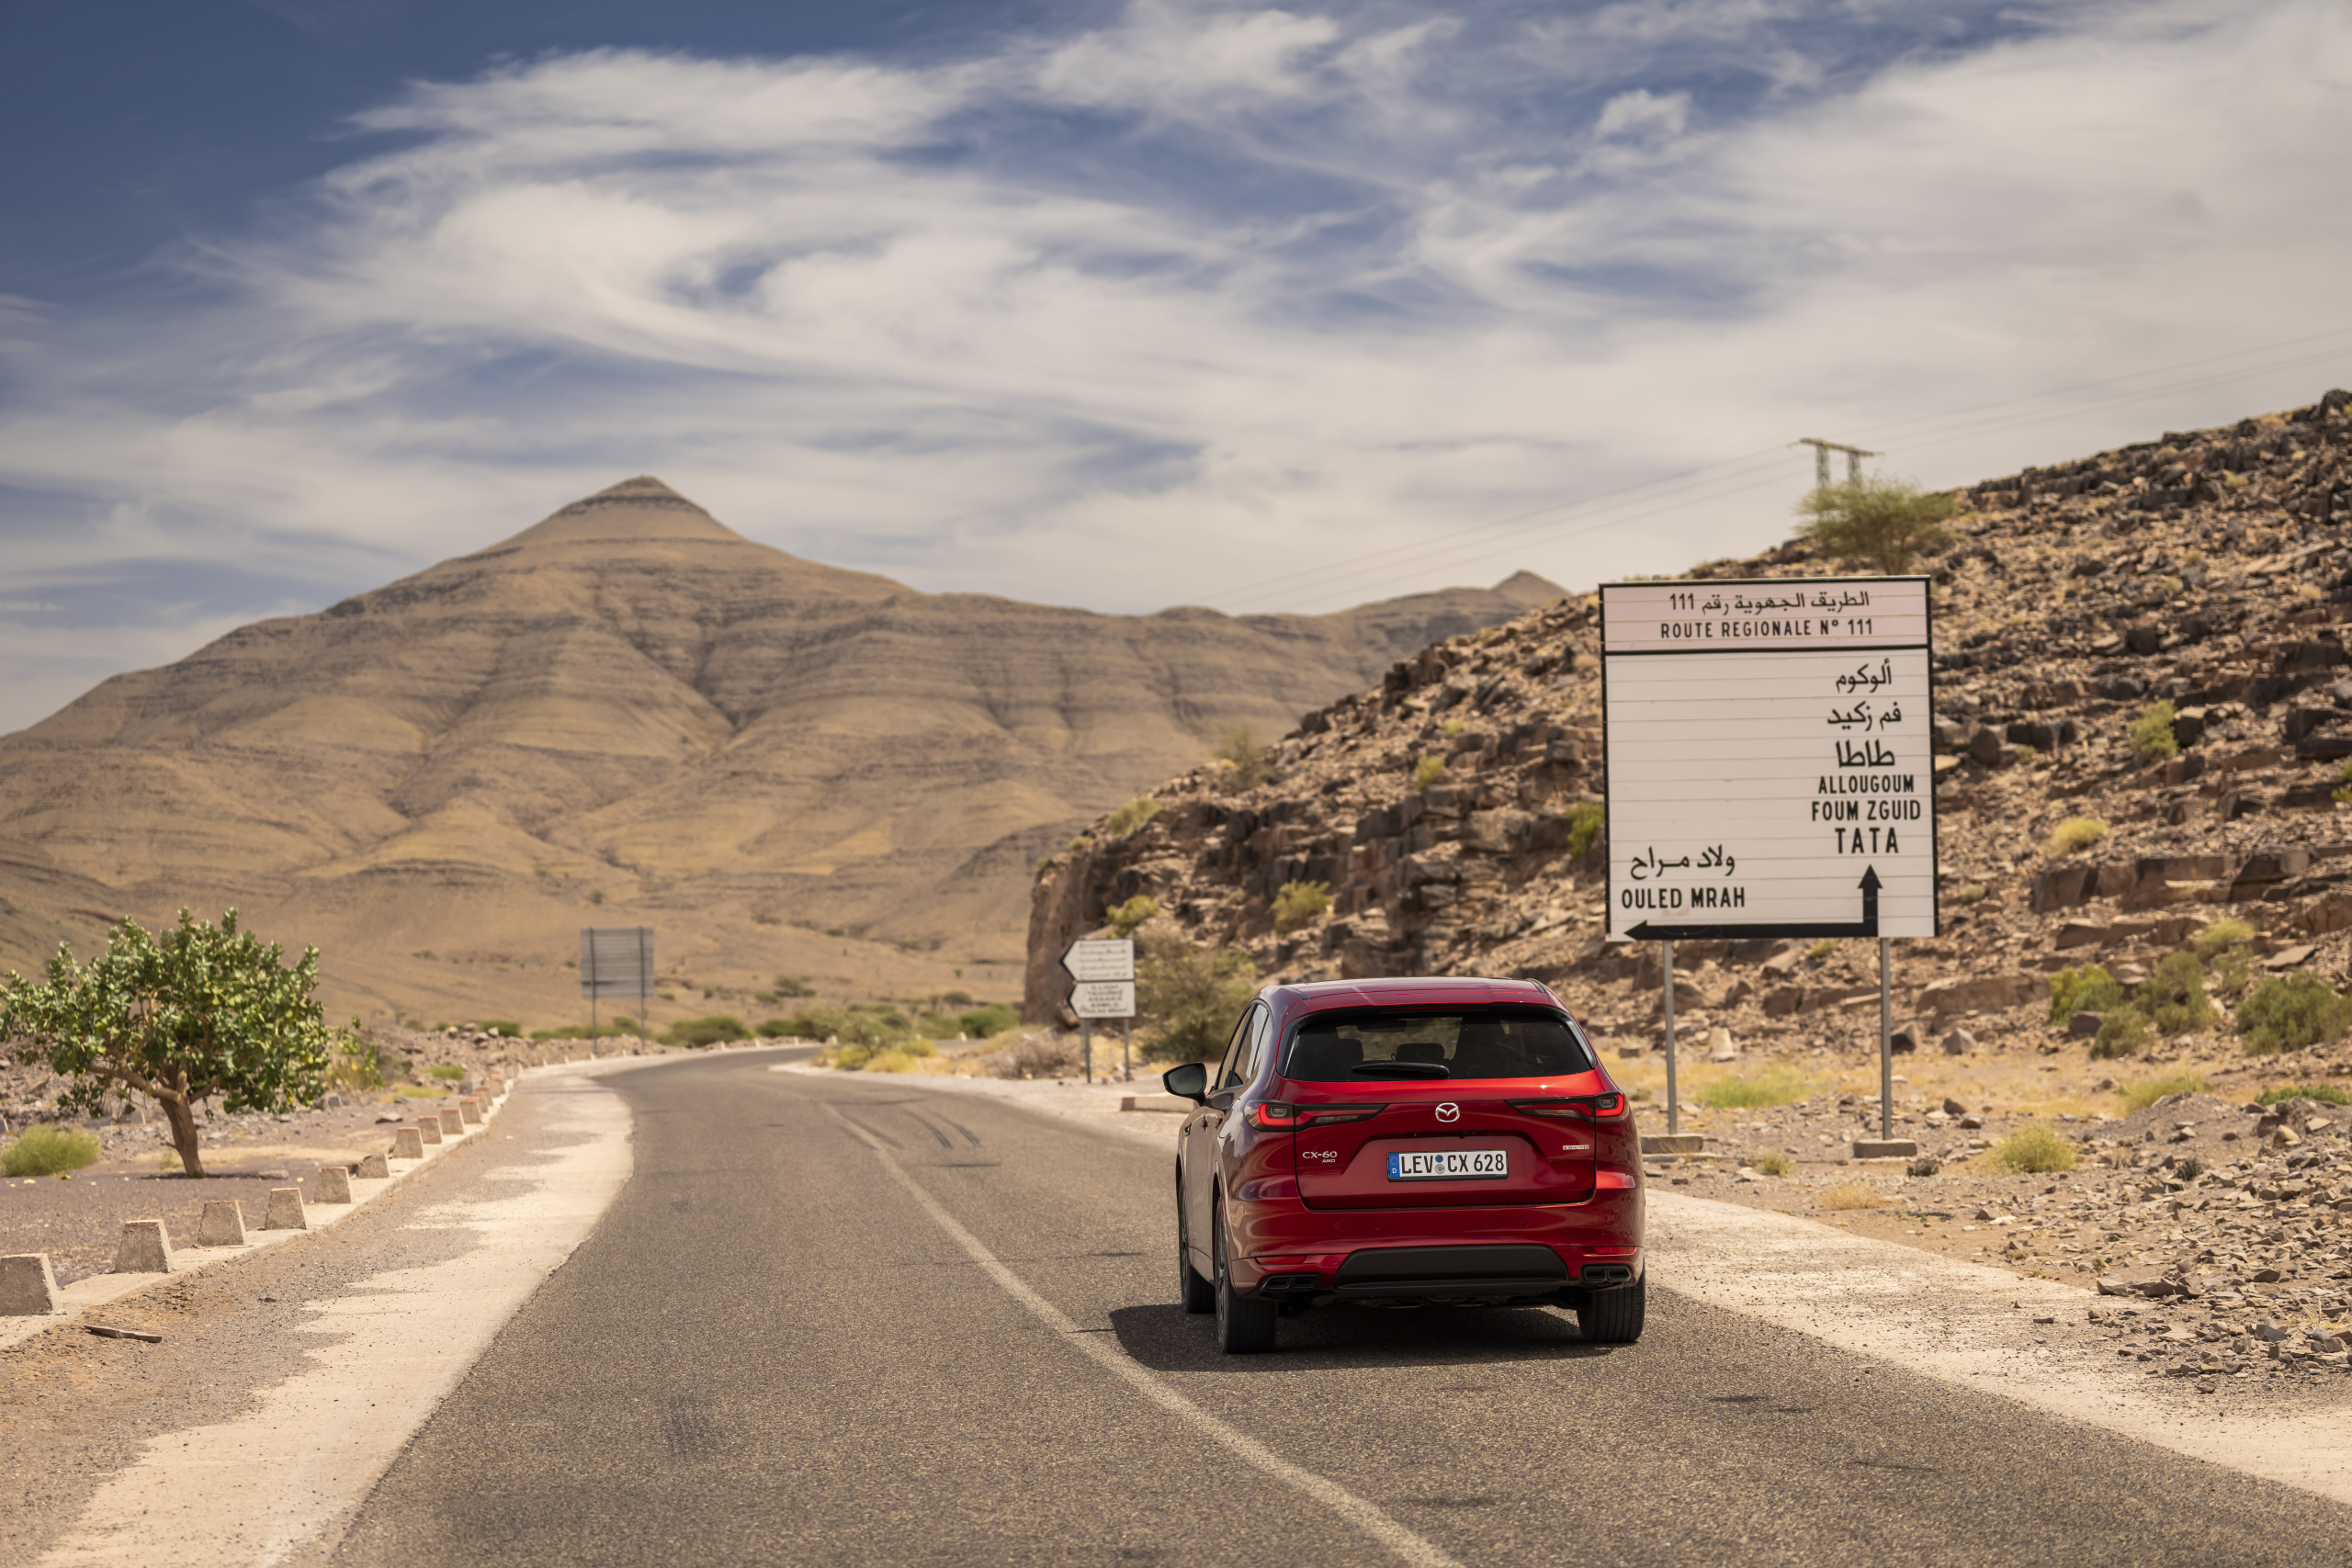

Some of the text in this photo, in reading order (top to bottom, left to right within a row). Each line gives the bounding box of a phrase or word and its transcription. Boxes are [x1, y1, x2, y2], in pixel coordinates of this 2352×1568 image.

[1669, 591, 1869, 615] الطريق الجهوية رقم 111
[1661, 622, 1713, 638] ROUTE
[1721, 619, 1812, 637] REGIONALE
[1848, 618, 1873, 635] 111
[1836, 658, 1893, 694] ألوكوم
[1827, 700, 1902, 731] فم زكيد
[1836, 739, 1895, 768] طاطا
[1818, 774, 1915, 795] ALLOUGOUM
[1811, 799, 1922, 821] FOUM ZGUID
[1835, 827, 1899, 854] TATA
[1630, 843, 1736, 881] ولاد مراح
[1622, 886, 1746, 909] OULED MRAH
[1302, 1150, 1338, 1159] CX-60
[1401, 1154, 1504, 1174] LEV CX 628
